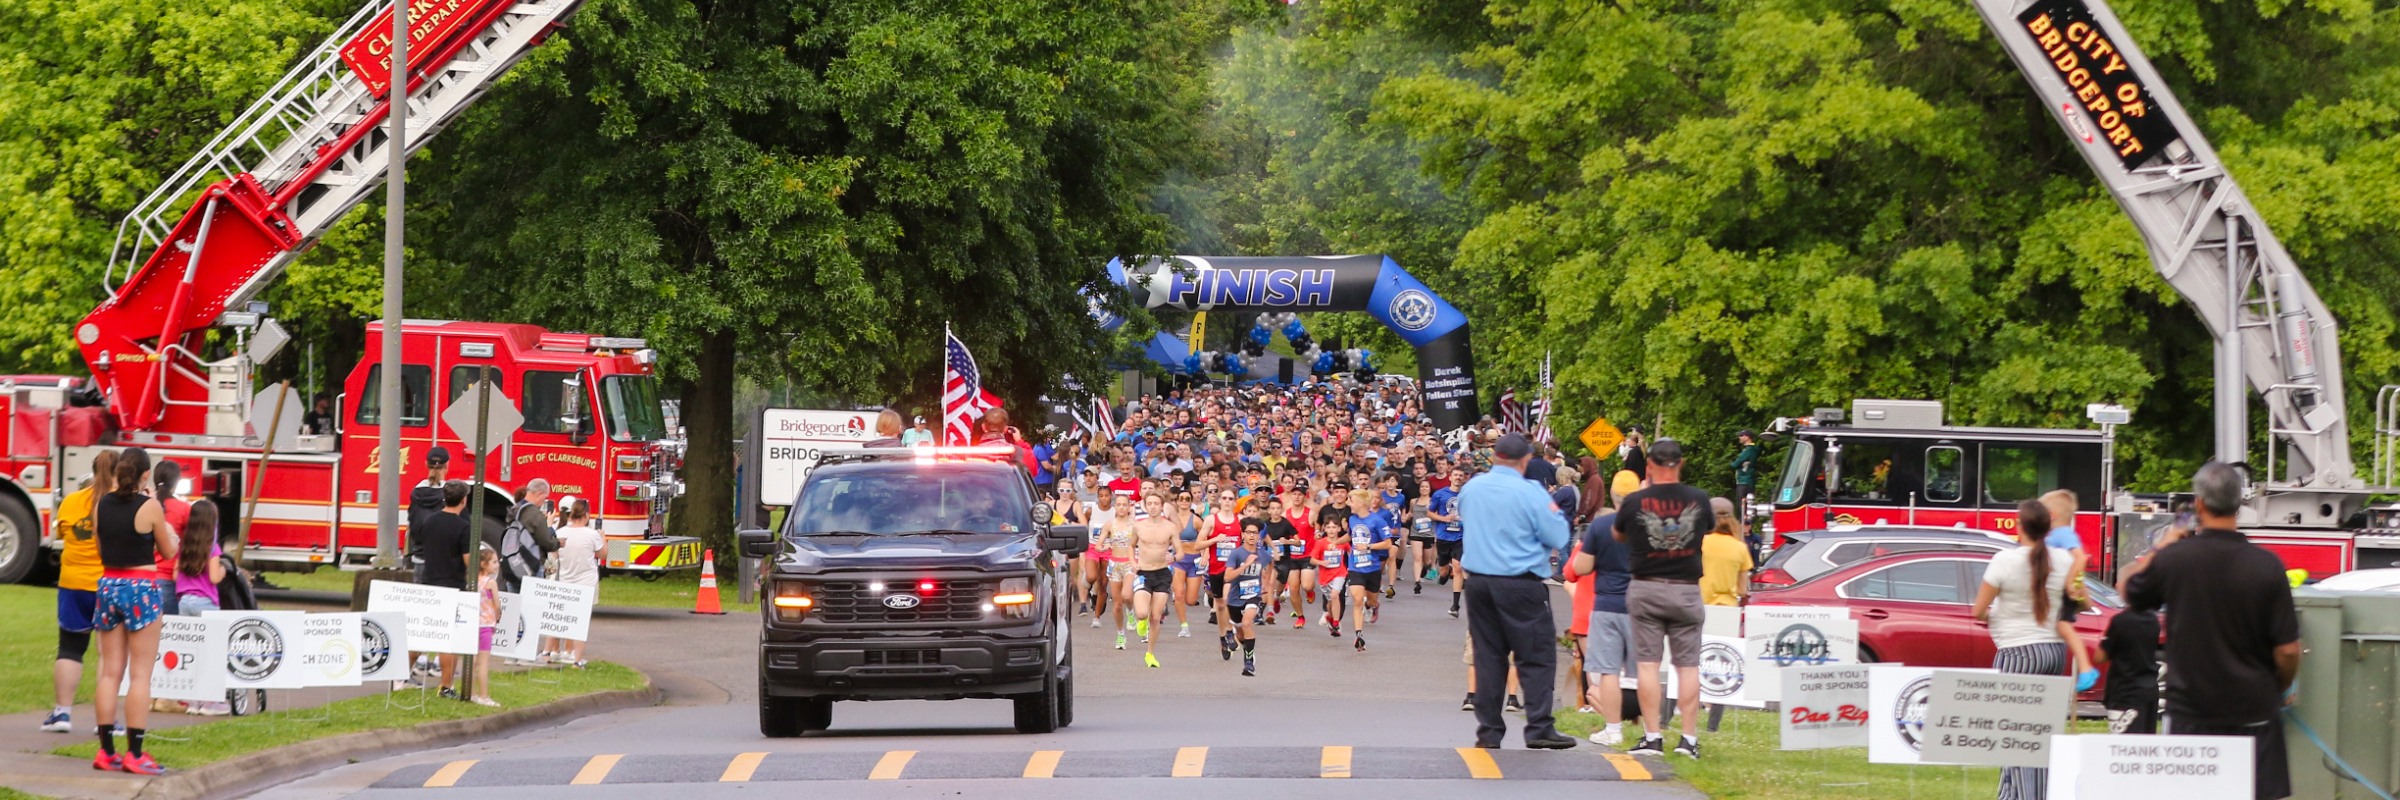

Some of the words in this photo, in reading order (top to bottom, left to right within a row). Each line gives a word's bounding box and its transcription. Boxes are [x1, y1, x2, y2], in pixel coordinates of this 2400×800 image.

[368, 0, 441, 56] CLRK
[379, 40, 415, 71] FIE
[412, 0, 465, 42] DEPAR
[2067, 21, 2128, 75] CITY
[2116, 82, 2146, 118] OF
[2028, 13, 2144, 157] BRIDGEPORT
[1168, 268, 1336, 305] FINISH
[1434, 366, 1462, 376] Derek
[1426, 390, 1452, 400] Fallen
[1453, 389, 1474, 398] Stars
[1054, 405, 1068, 414] 5K
[1445, 401, 1459, 409] 5K
[780, 419, 847, 436] Bridgeport
[770, 447, 820, 461] BRIDG
[517, 455, 535, 465] CITY
[535, 453, 546, 462] OF
[548, 453, 597, 469] CLARKSBURG
[551, 484, 583, 494] VIRGINIA
[1994, 517, 2018, 529] TO
[391, 586, 423, 595] THANKS
[535, 583, 557, 592] THANK
[559, 586, 571, 594] YOU
[403, 596, 441, 606] SPONSOR
[534, 590, 548, 598] OUR
[550, 592, 580, 602] SPONSOR
[890, 596, 914, 607] Ford
[548, 602, 565, 611] THE
[406, 616, 421, 625] ain
[422, 616, 449, 629] State
[542, 611, 578, 624] RASHER
[171, 622, 191, 631] YOU
[193, 623, 206, 632] TO
[406, 629, 450, 640] nsulation
[317, 654, 345, 664] ZONE
[1800, 670, 1835, 679] THANK
[1839, 670, 1860, 679] YOU
[1800, 682, 1822, 691] OUR
[1825, 682, 1868, 691] SPONSO
[1956, 679, 1997, 690] THANK
[2001, 682, 2026, 692] YOU
[2030, 683, 2046, 693] TO
[1953, 692, 1980, 702] OUR
[1984, 693, 2043, 705] SPONSOR
[1790, 706, 1831, 724] Dan
[1837, 704, 1868, 726] Rig
[1935, 716, 1963, 729] J.E.
[1968, 717, 1994, 731] Hitt
[1997, 718, 2052, 736] Garage
[1941, 735, 1953, 747] &
[1957, 735, 1997, 751] Body
[2000, 737, 2042, 753] Shop
[2109, 744, 2160, 757] THANK
[2163, 745, 2195, 758] YOU
[2198, 746, 2219, 759] TO
[2109, 762, 2141, 774] OUR
[2145, 763, 2218, 776] SPONSOR
